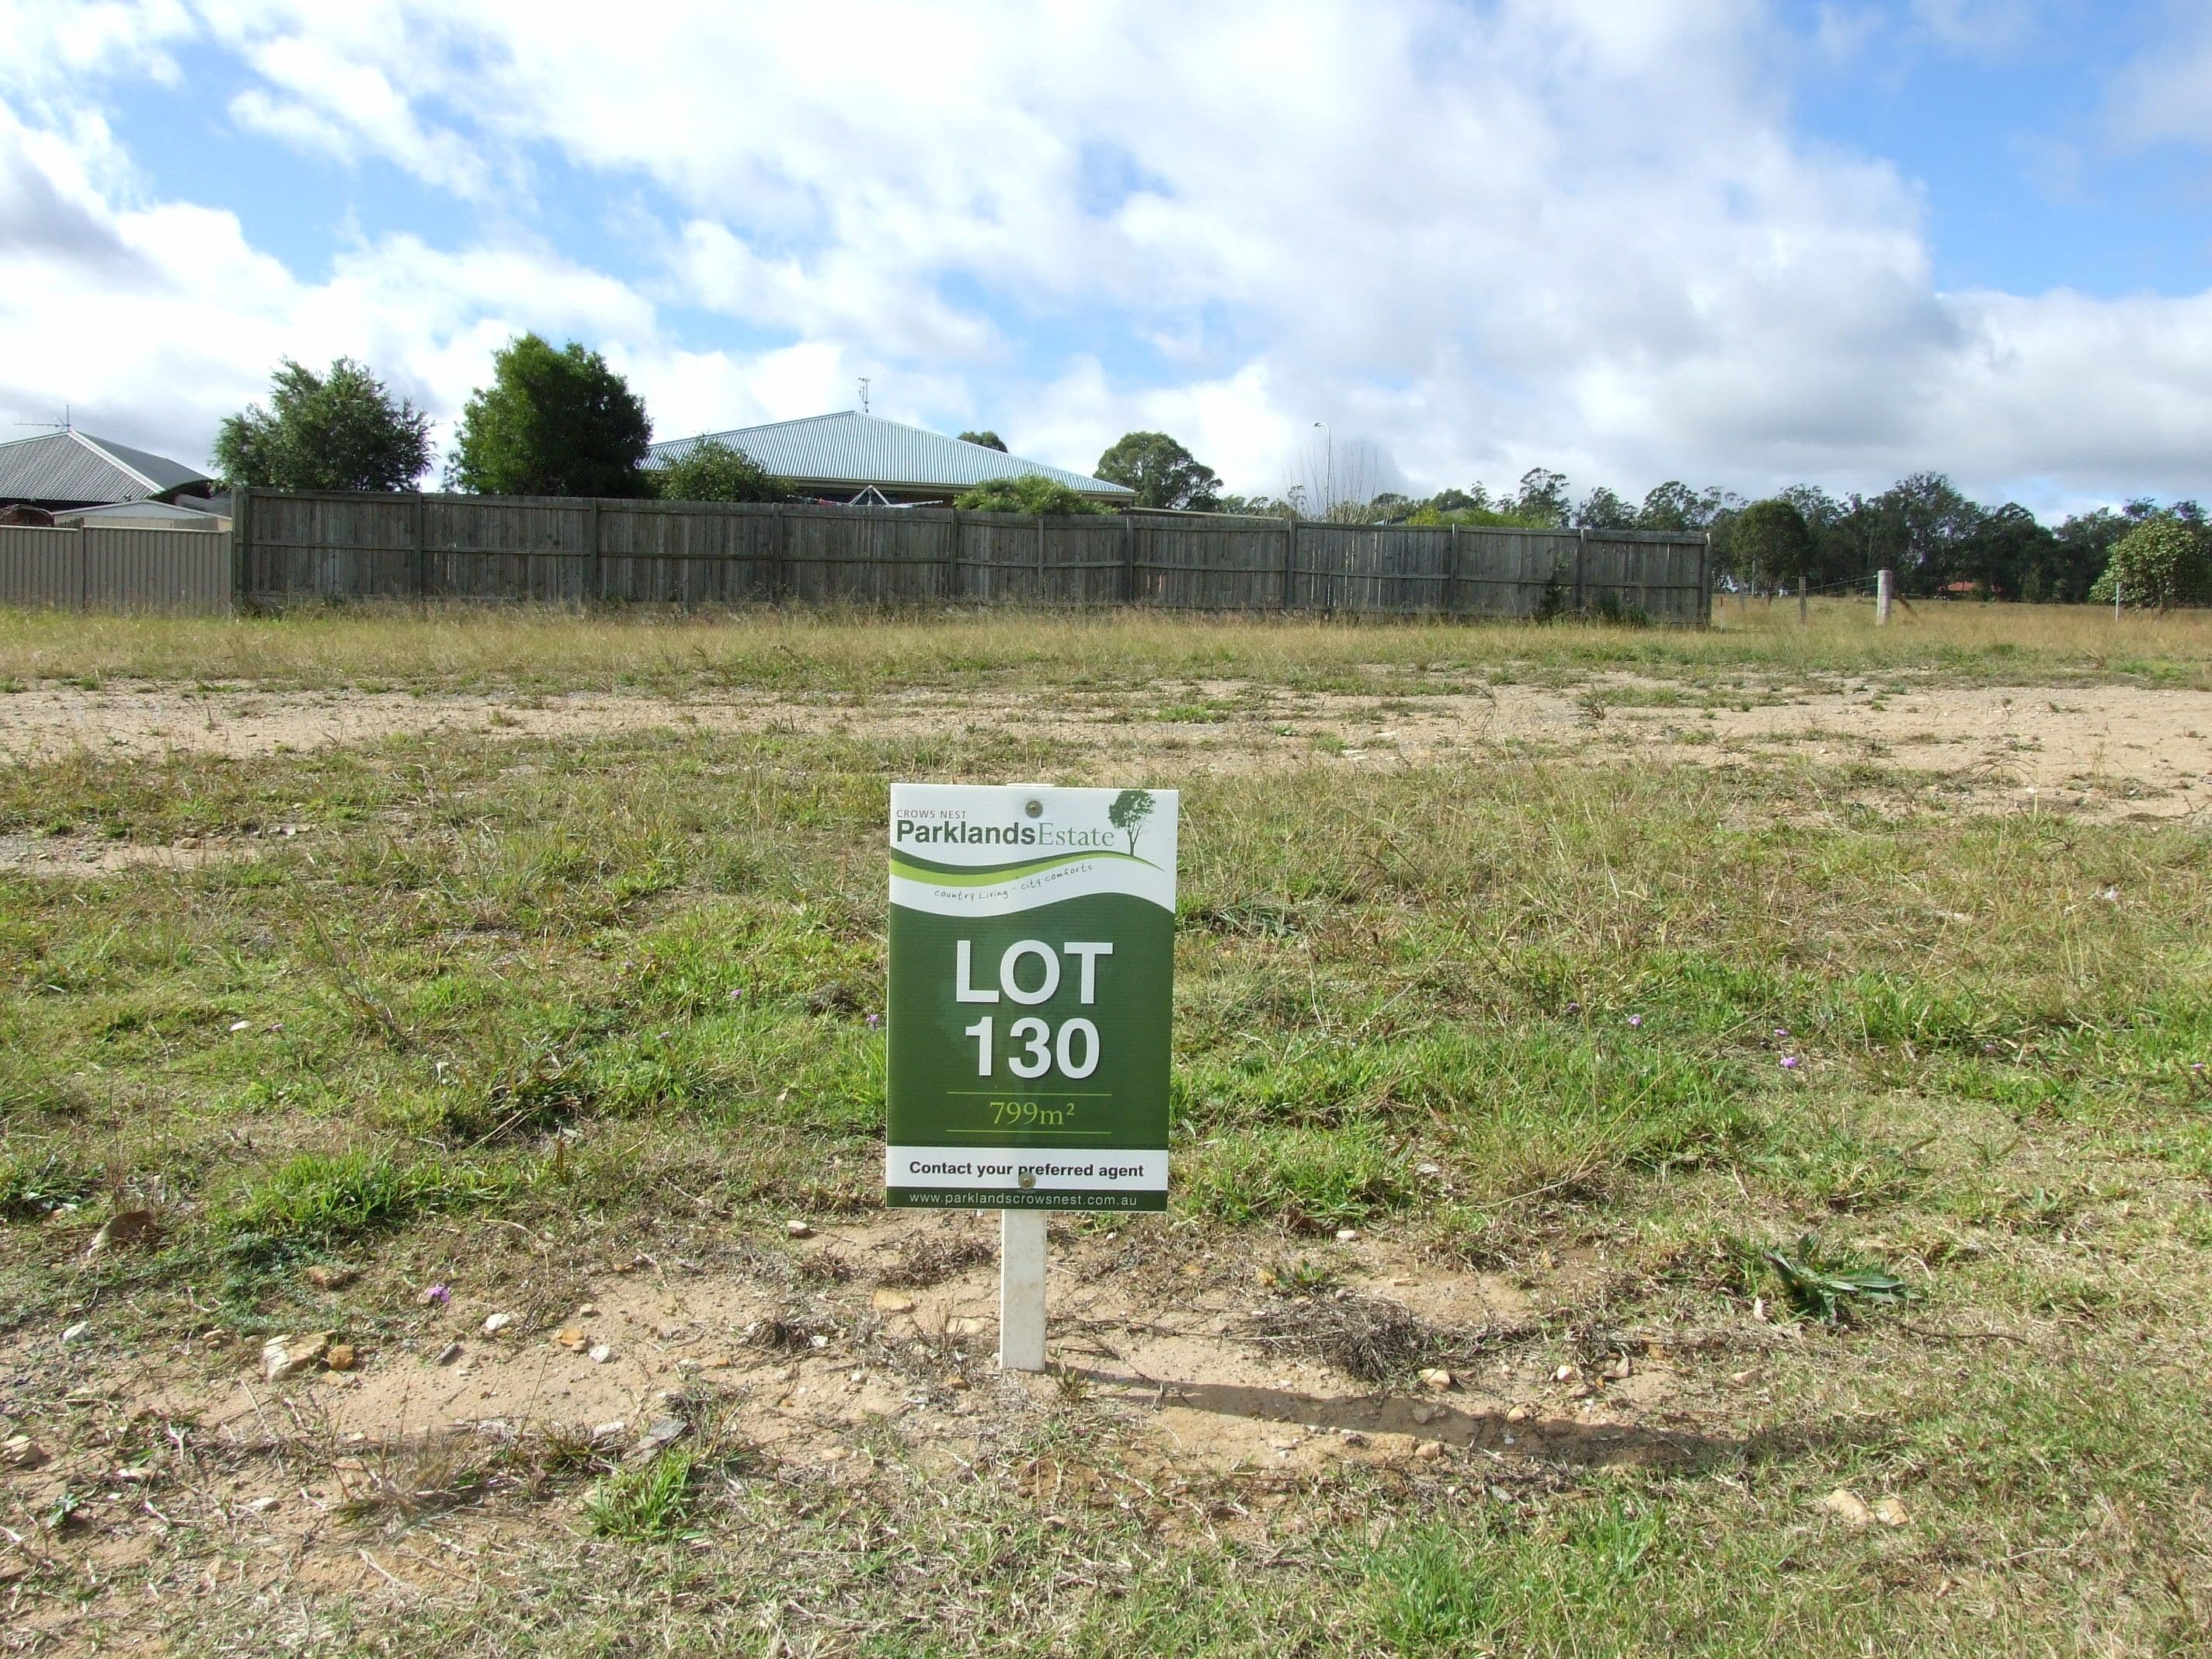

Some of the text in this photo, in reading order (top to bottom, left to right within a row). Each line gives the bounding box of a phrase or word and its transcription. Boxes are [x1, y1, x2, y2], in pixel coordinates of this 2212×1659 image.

[896, 809, 966, 819] CROWS NEST
[1045, 864, 1094, 882] comforts
[956, 940, 1113, 1005] LOT
[965, 1016, 1100, 1079] 130
[909, 1161, 972, 1175] Contact
[977, 1164, 1012, 1177] your
[1099, 1164, 1144, 1179] agent
[909, 1192, 1137, 1206] www.parklandscrowsnest.com.au
